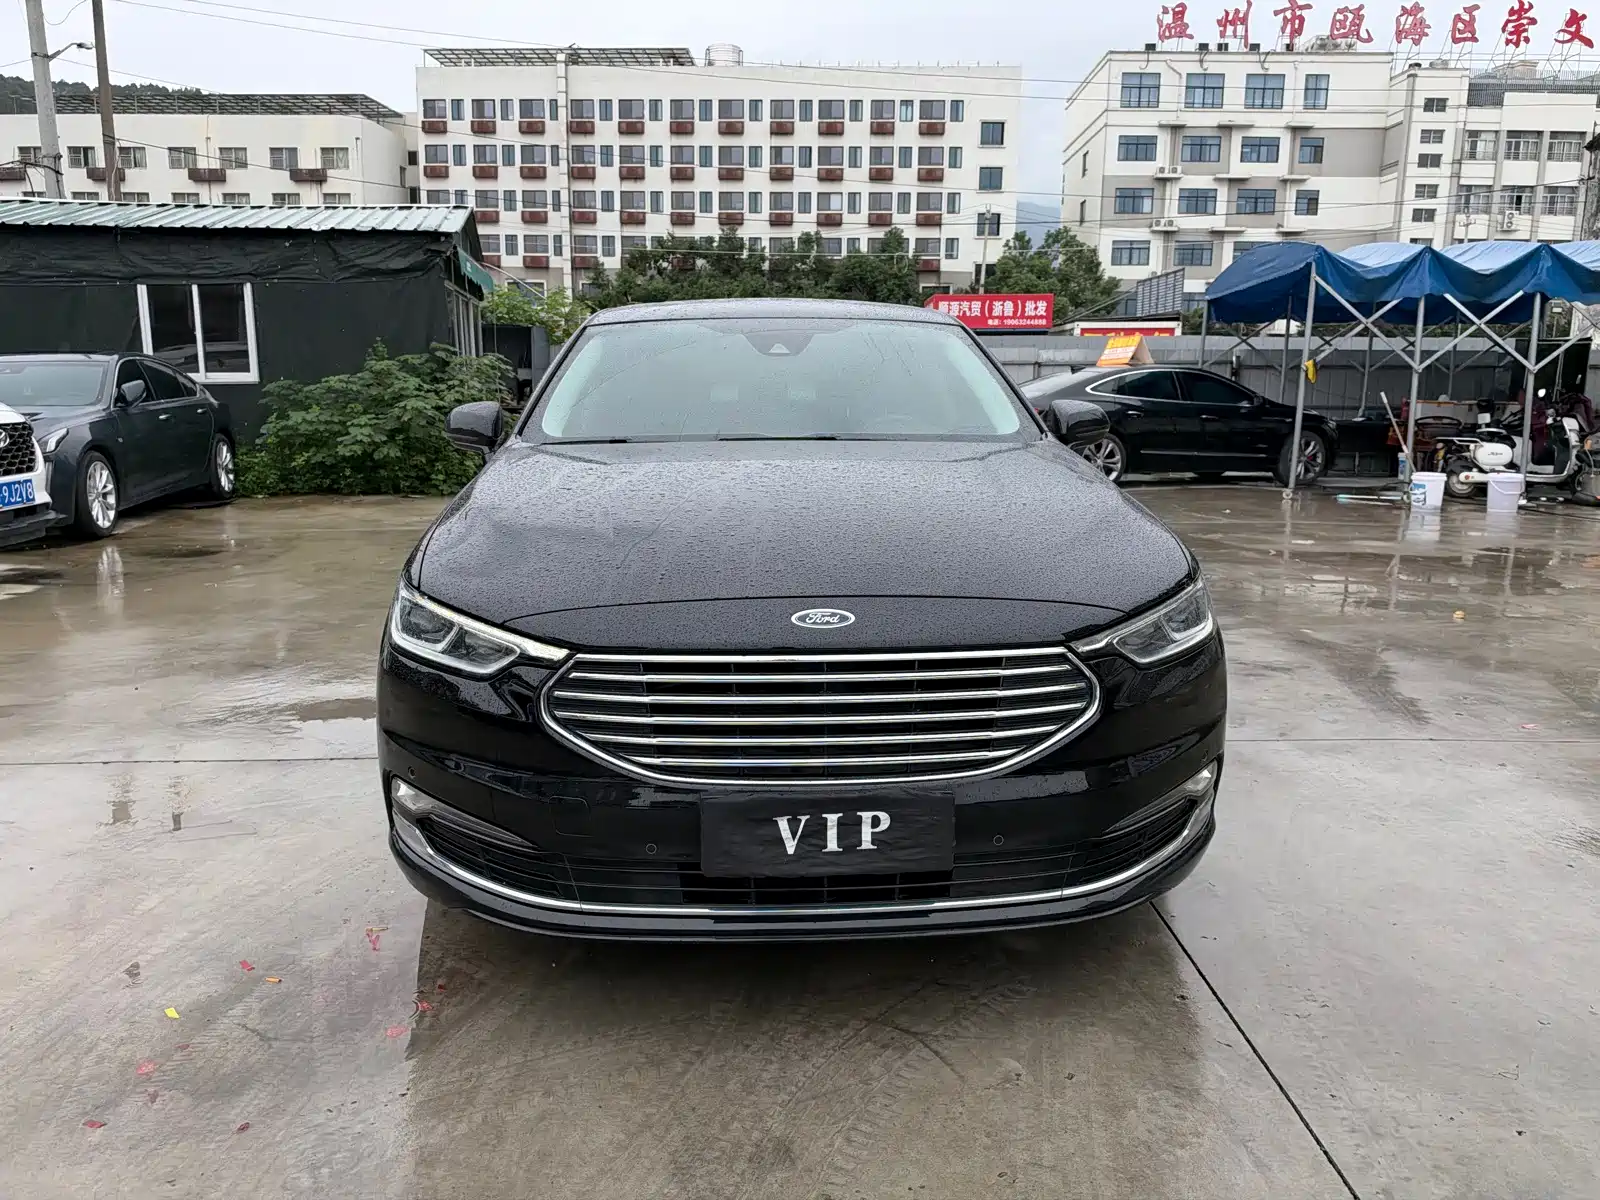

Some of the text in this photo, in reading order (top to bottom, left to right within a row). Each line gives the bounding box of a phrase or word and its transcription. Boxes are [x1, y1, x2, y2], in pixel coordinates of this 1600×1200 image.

[1157, 0, 1595, 49] 温州市瓯海区崇文
[805, 612, 841, 624] Ford
[773, 811, 891, 855] VIP
